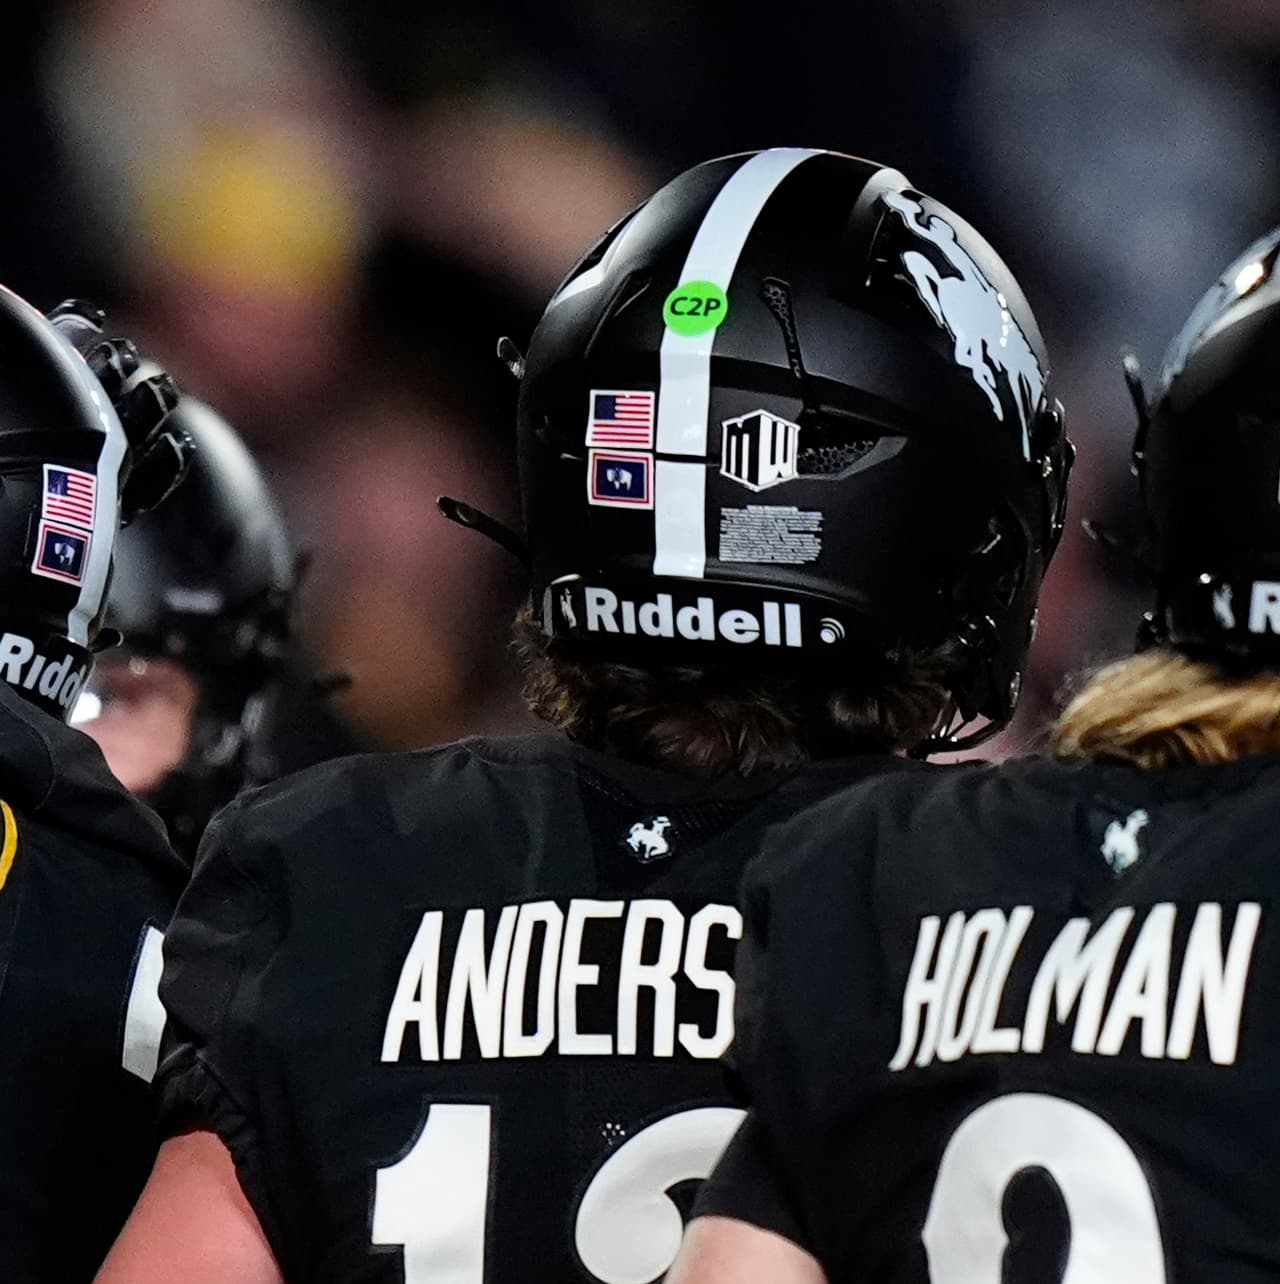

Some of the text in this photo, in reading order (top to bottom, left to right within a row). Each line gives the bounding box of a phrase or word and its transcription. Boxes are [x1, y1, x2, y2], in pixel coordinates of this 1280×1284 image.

[669, 296, 721, 317] C2P
[584, 586, 802, 648] Riddell
[889, 902, 1262, 1072] HOLMAN
